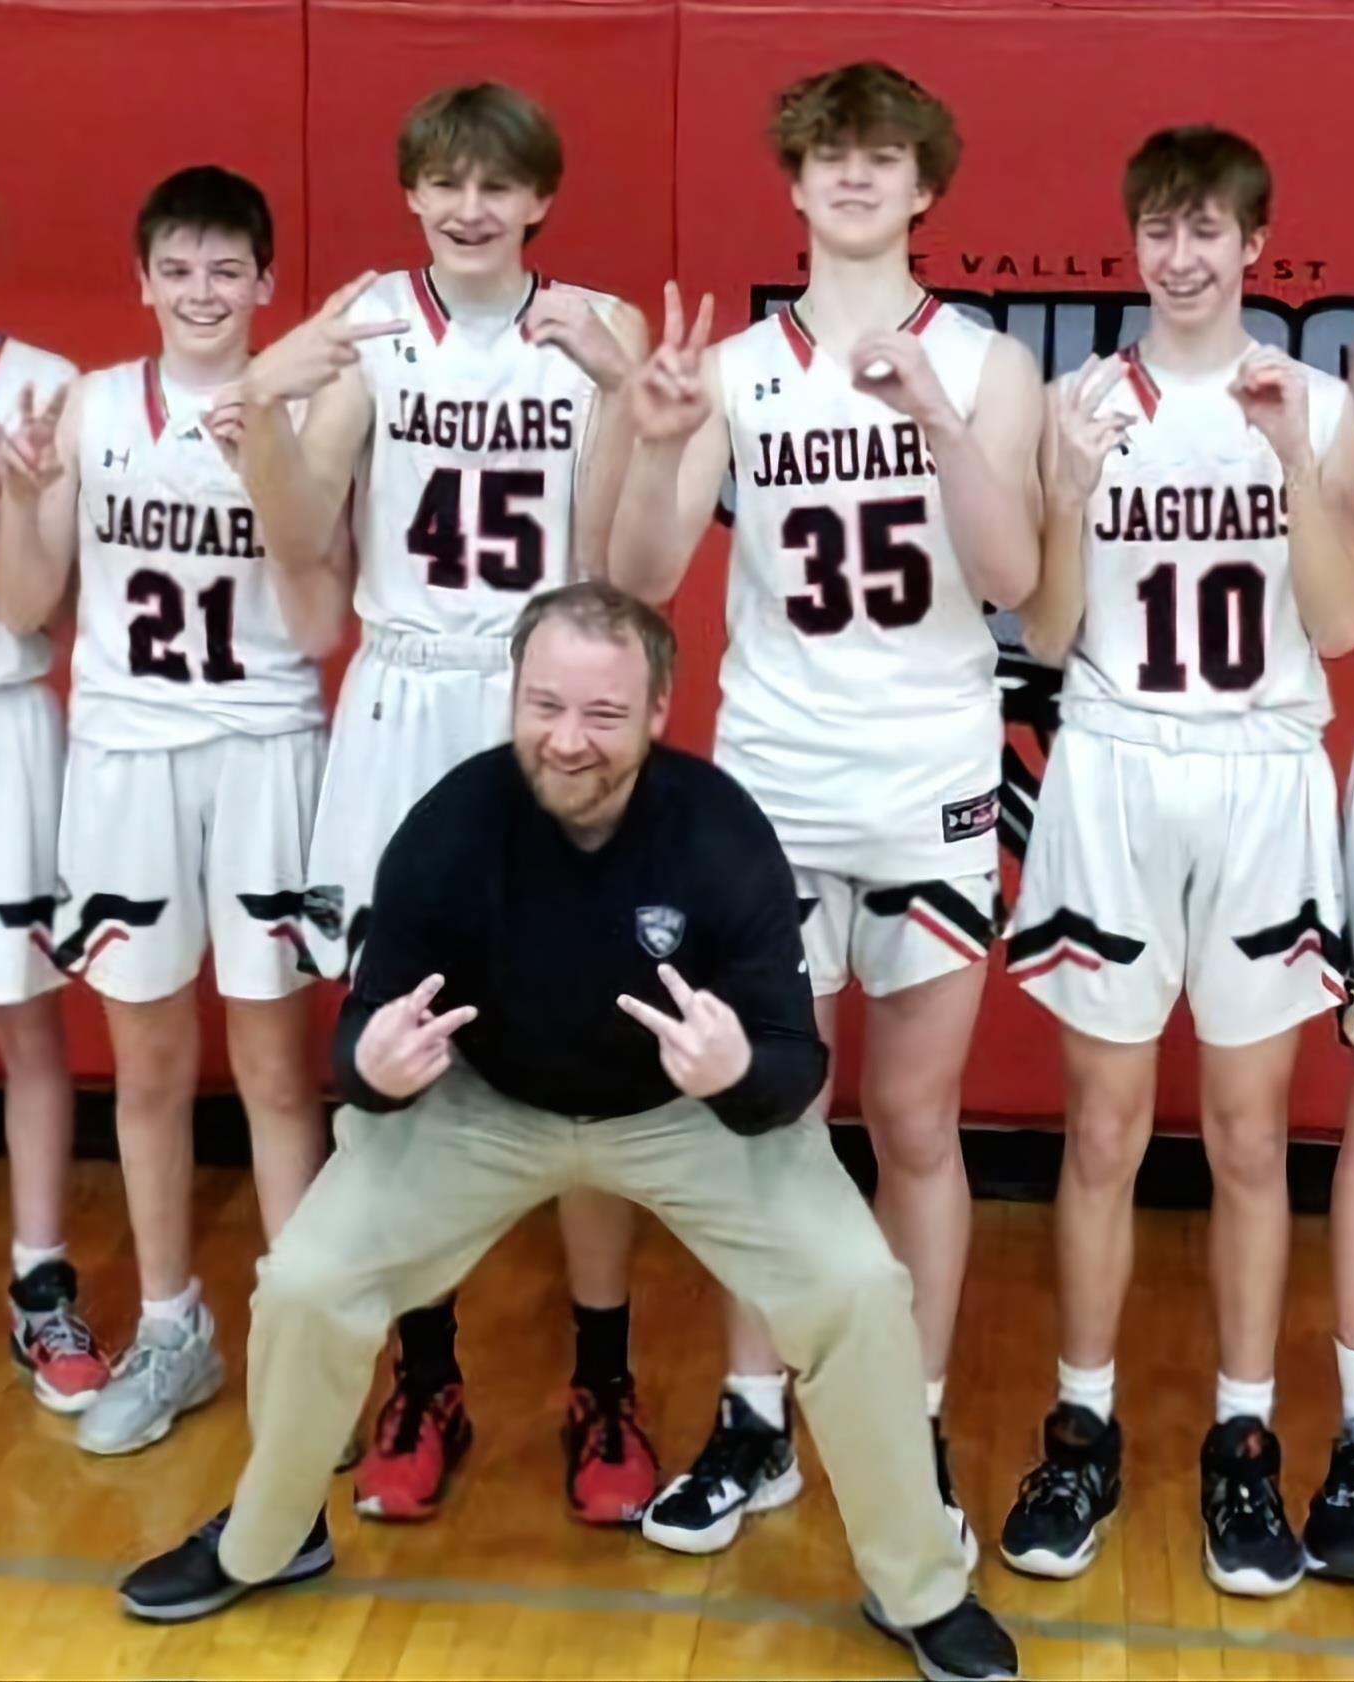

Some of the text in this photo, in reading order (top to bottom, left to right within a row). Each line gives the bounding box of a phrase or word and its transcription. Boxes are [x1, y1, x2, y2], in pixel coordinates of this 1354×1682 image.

[961, 253, 1327, 281] VALLE ST
[388, 388, 573, 452] JAGUARS
[753, 422, 936, 488] JAGUAR
[96, 494, 265, 558] JAGUAR
[405, 467, 544, 592] 45
[780, 494, 933, 636] 35
[126, 567, 246, 684] 21
[1136, 560, 1266, 693] 10
